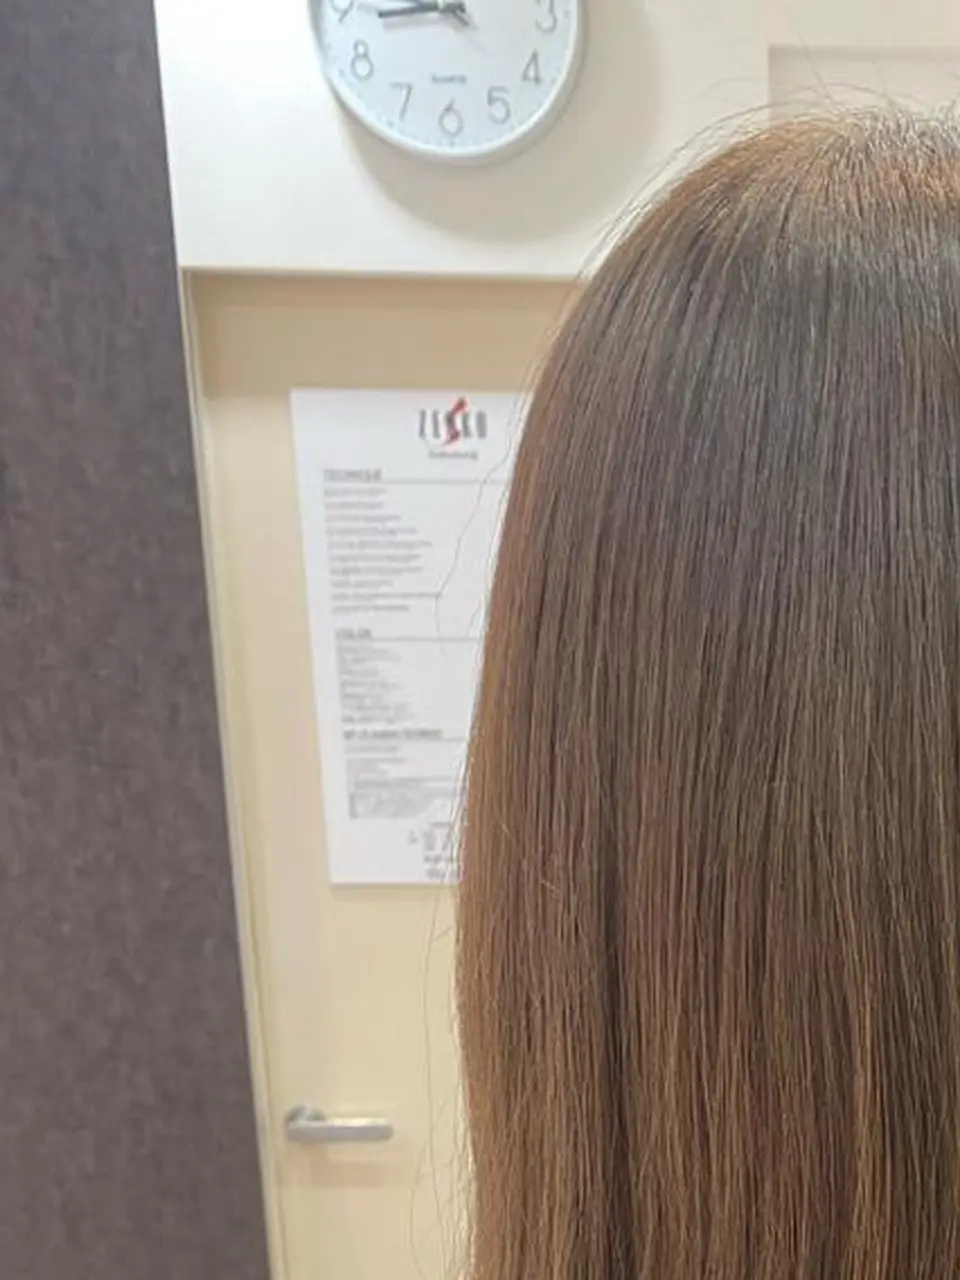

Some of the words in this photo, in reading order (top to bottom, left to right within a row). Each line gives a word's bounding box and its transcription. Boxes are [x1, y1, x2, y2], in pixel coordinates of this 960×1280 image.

[350, 39, 374, 81] 8
[522, 48, 541, 85] 4
[391, 82, 413, 121] 7
[438, 97, 463, 138] 6
[487, 86, 510, 125] 5
